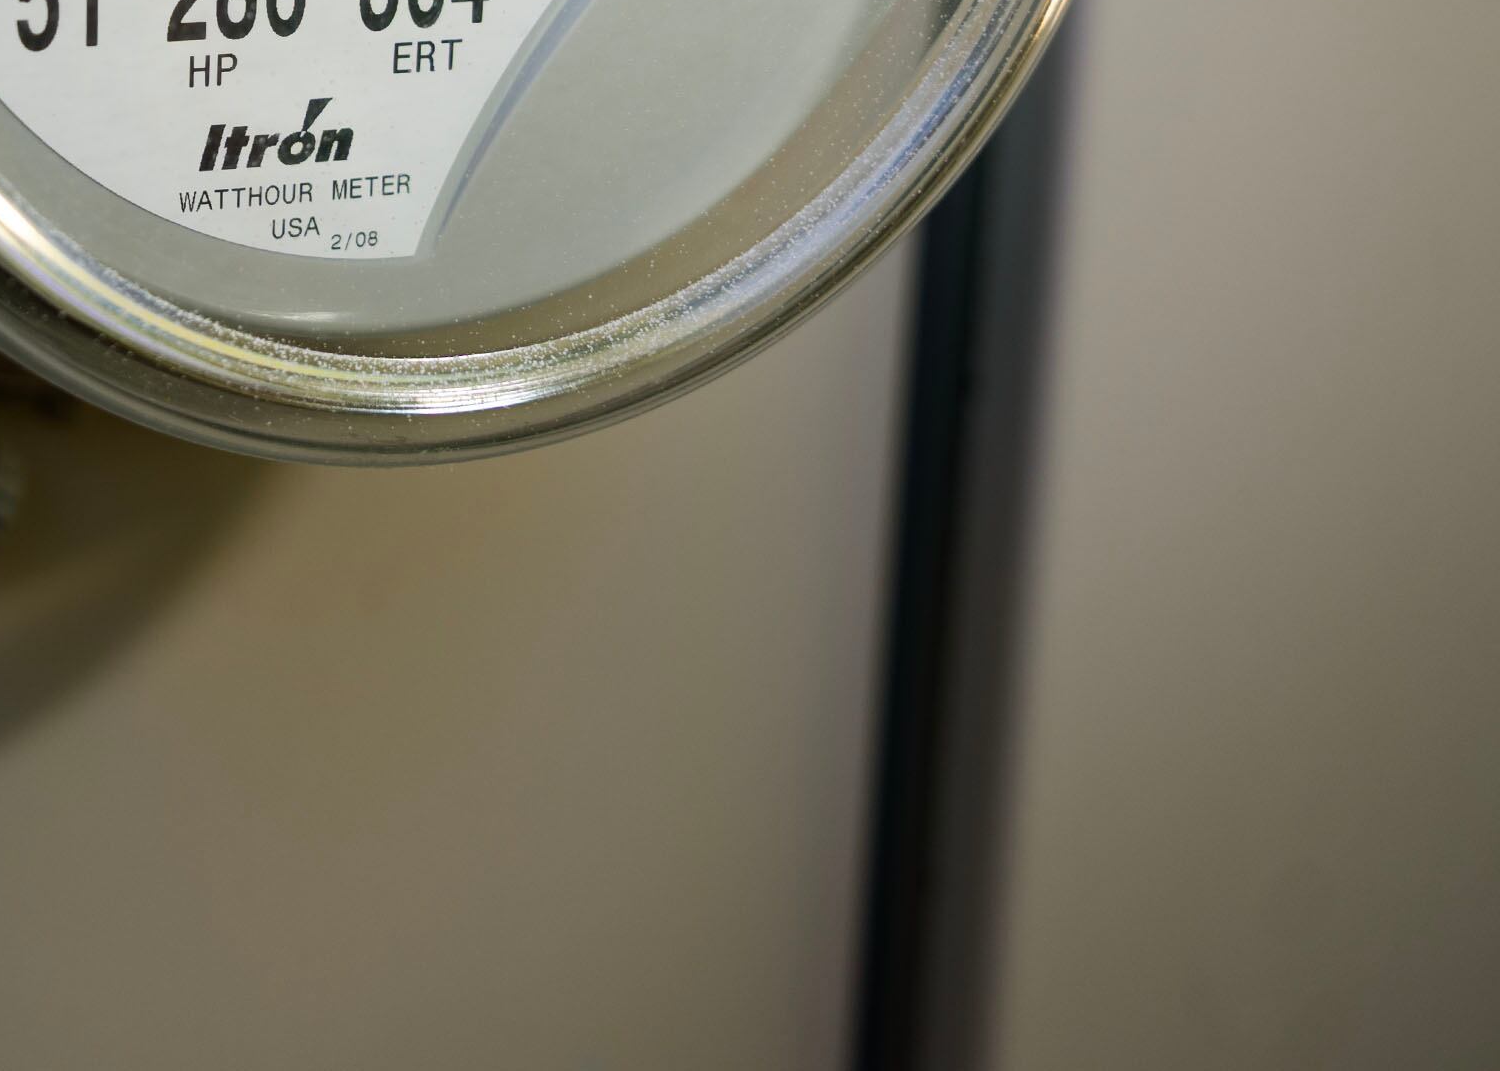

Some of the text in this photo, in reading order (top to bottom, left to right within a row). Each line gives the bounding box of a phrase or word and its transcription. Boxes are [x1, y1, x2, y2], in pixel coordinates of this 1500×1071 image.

[188, 53, 238, 88] HP
[392, 39, 463, 74] ERT
[179, 174, 411, 213] WATTHOUR METER
[271, 216, 321, 240] USA
[330, 231, 379, 251] 2/08
